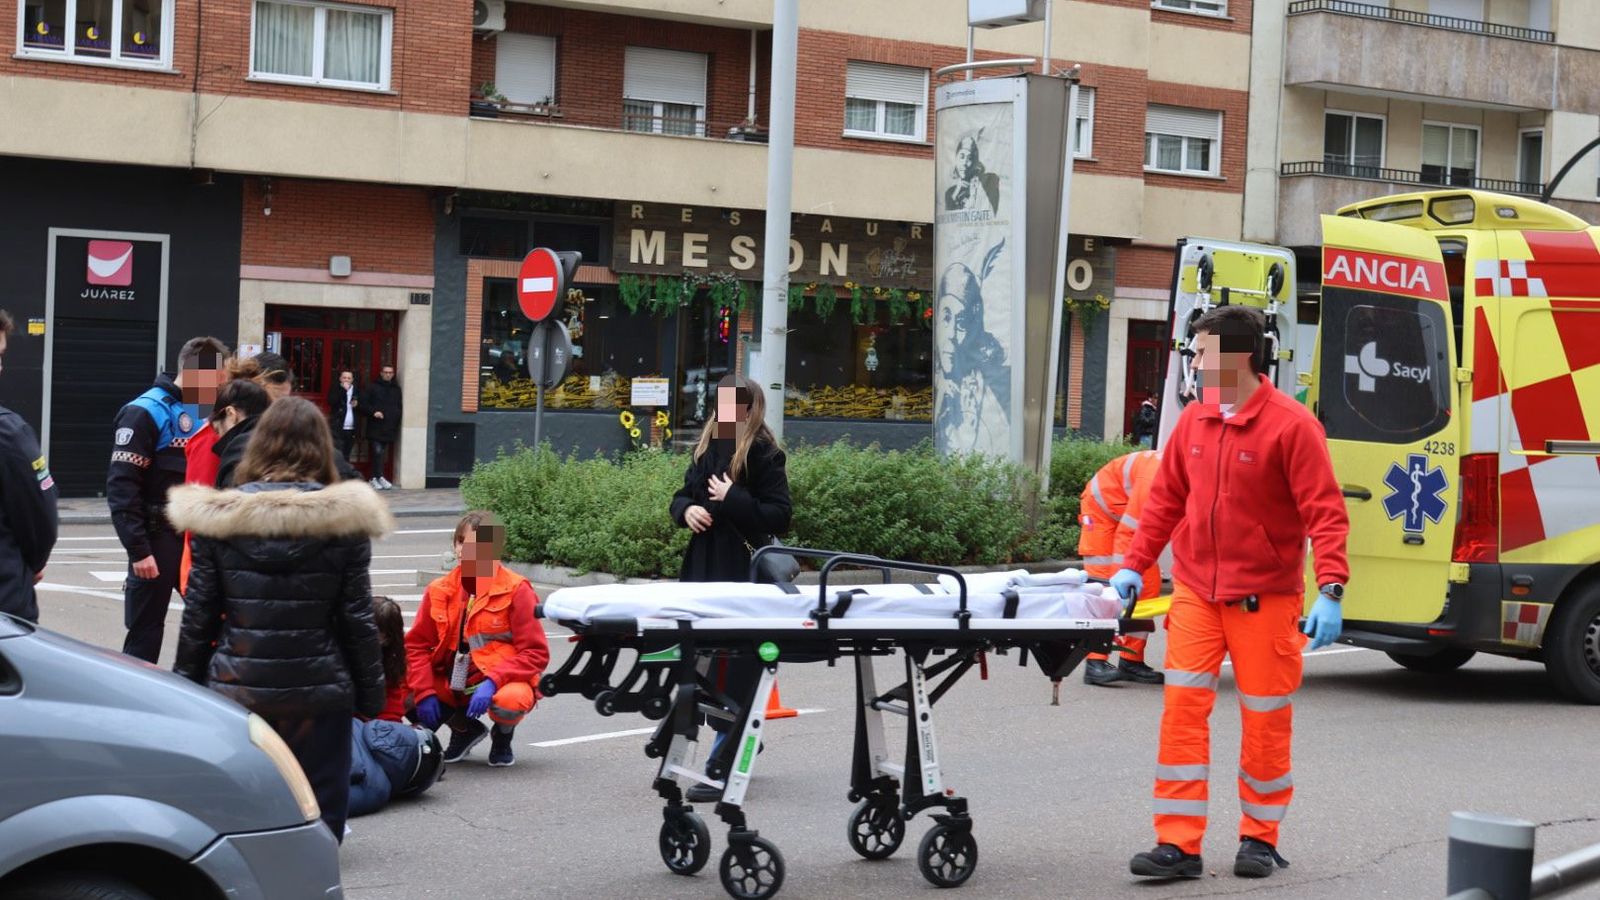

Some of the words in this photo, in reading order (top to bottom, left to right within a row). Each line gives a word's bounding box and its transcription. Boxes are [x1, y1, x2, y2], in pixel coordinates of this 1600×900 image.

[1324, 255, 1430, 292] ANCIA
[1393, 362, 1430, 383] Sacyl
[1424, 440, 1455, 456] 4238
